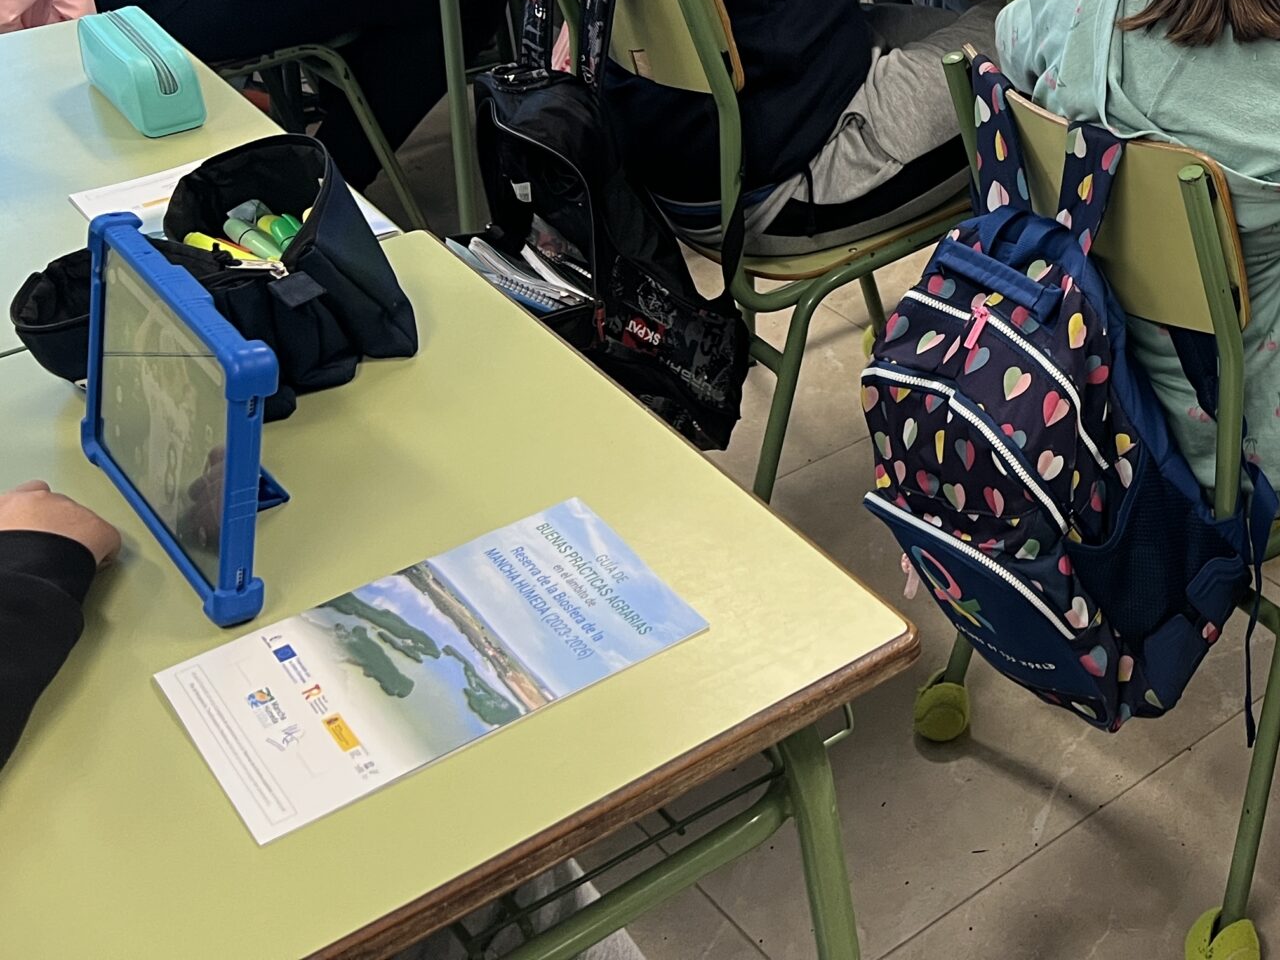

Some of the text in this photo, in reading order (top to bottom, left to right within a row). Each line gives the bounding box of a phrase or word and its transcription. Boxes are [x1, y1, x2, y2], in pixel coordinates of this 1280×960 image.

[626, 320, 662, 346] SKPAT
[484, 548, 594, 661] MANCHA HÚMEDA (2023-2026)
[510, 546, 604, 643] Reserva de la Biosfera de la
[536, 522, 653, 636] BUENAS PRÁCTICAS AGRARIAS
[615, 570, 629, 584] DE
